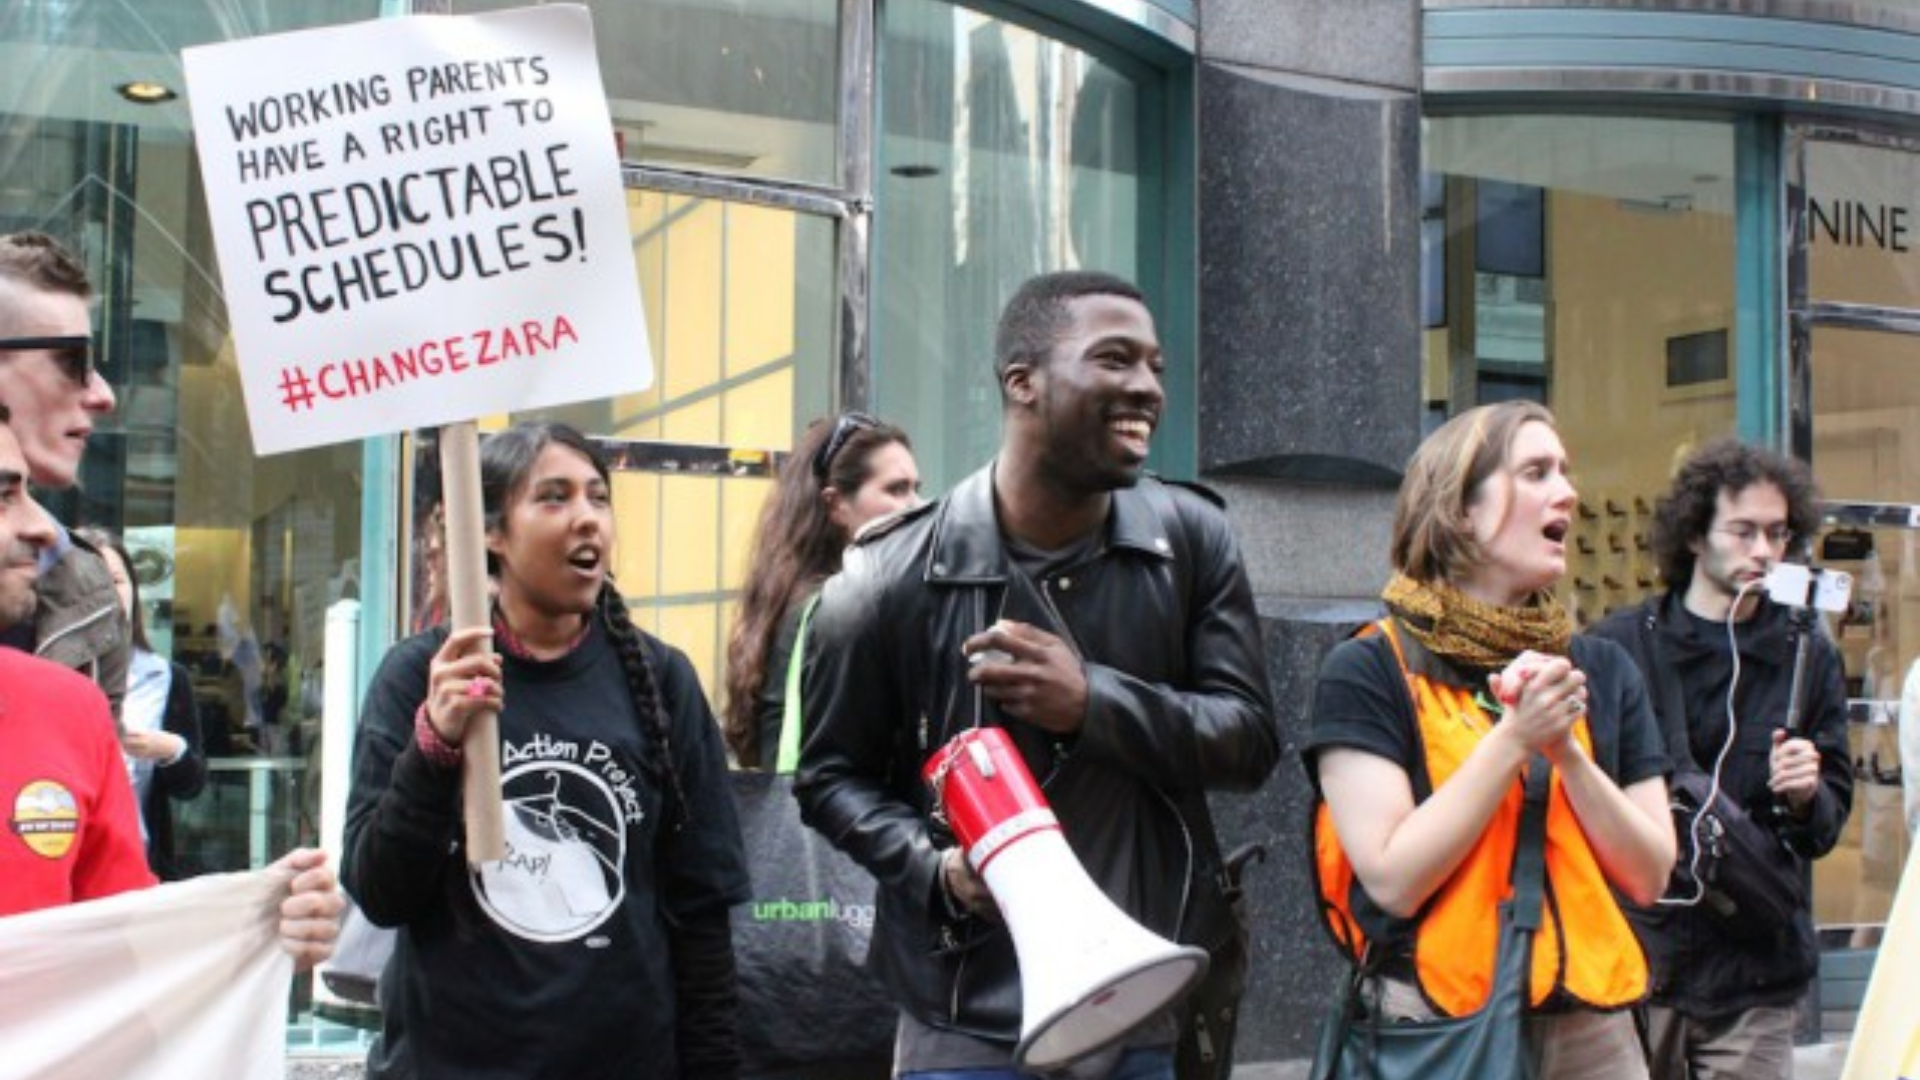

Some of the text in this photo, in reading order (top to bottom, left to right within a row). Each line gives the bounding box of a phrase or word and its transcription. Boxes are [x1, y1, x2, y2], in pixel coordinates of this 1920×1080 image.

[226, 56, 550, 142] WORKING PARENTS
[237, 98, 555, 184] HAVE A RIGHT TO
[245, 143, 578, 262] PREDICTABLE
[1808, 197, 1909, 253] NINE
[264, 207, 589, 324] SCHEDULES!
[278, 314, 579, 413] #CHANGEZARA
[502, 732, 645, 825] Action Project
